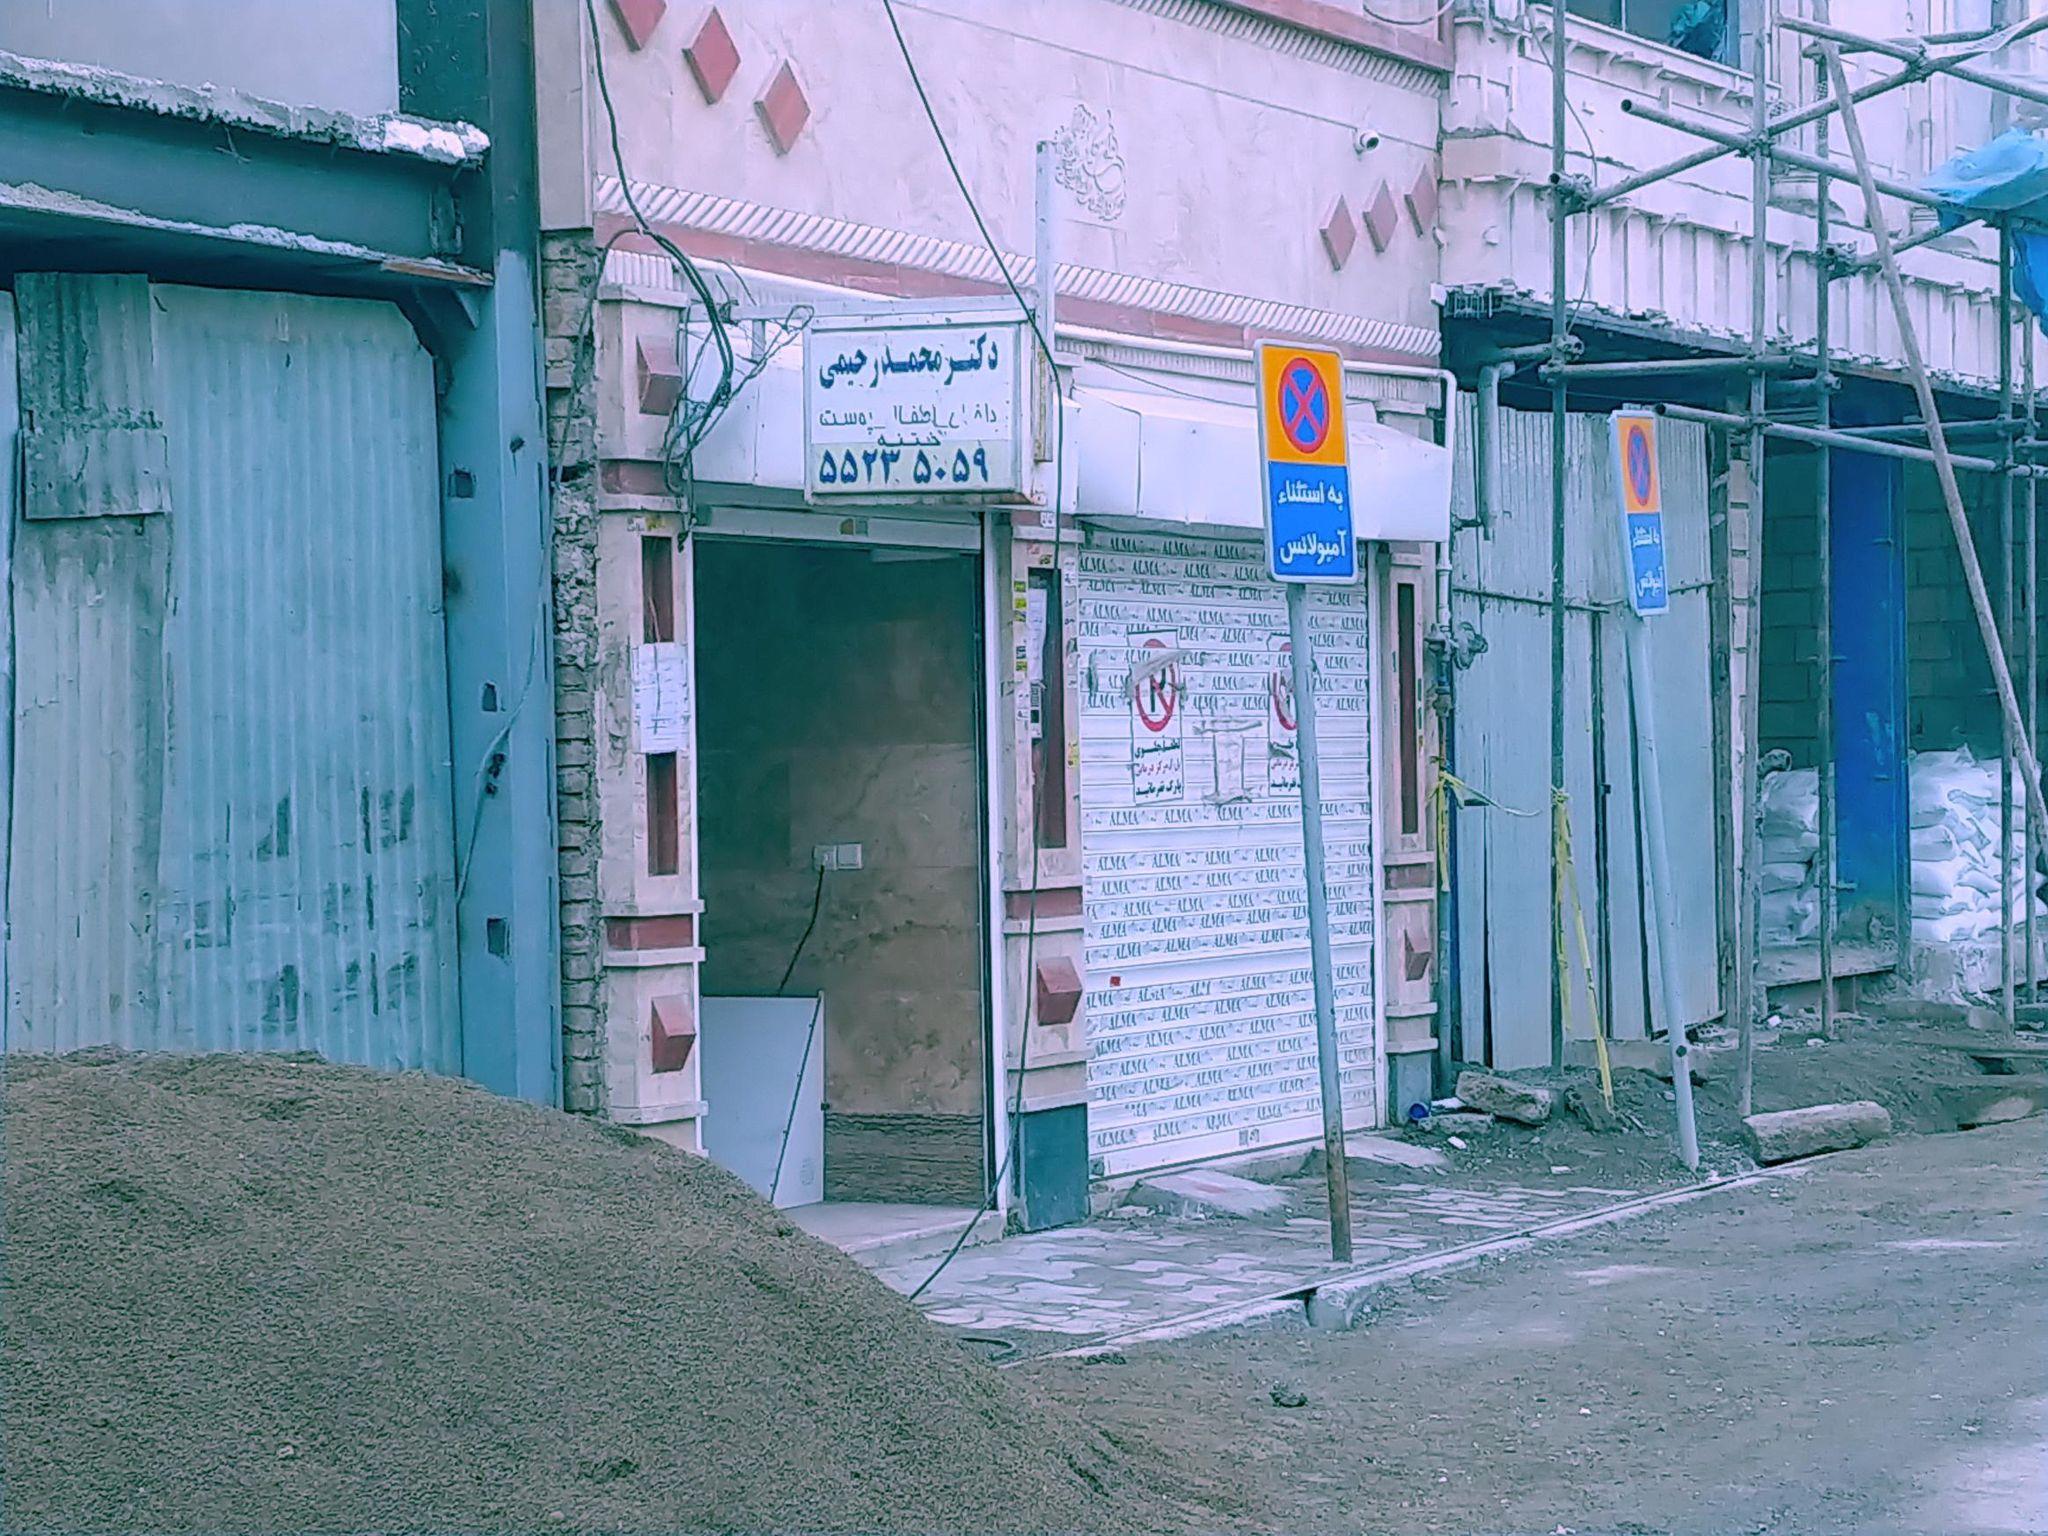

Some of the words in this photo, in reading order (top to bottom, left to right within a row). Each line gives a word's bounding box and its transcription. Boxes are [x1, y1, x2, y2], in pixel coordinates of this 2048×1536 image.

[818, 348, 880, 389] رحیمی
[881, 344, 944, 374] محمد
[943, 331, 999, 386] دکتر
[876, 431, 941, 448] ختنه
[818, 448, 901, 485] ۵۵۲۳
[912, 446, 989, 485] ۵۰۵۹
[1277, 480, 1325, 505] استثناء
[1327, 486, 1344, 511] به
[1279, 529, 1347, 565] آمبولانس
